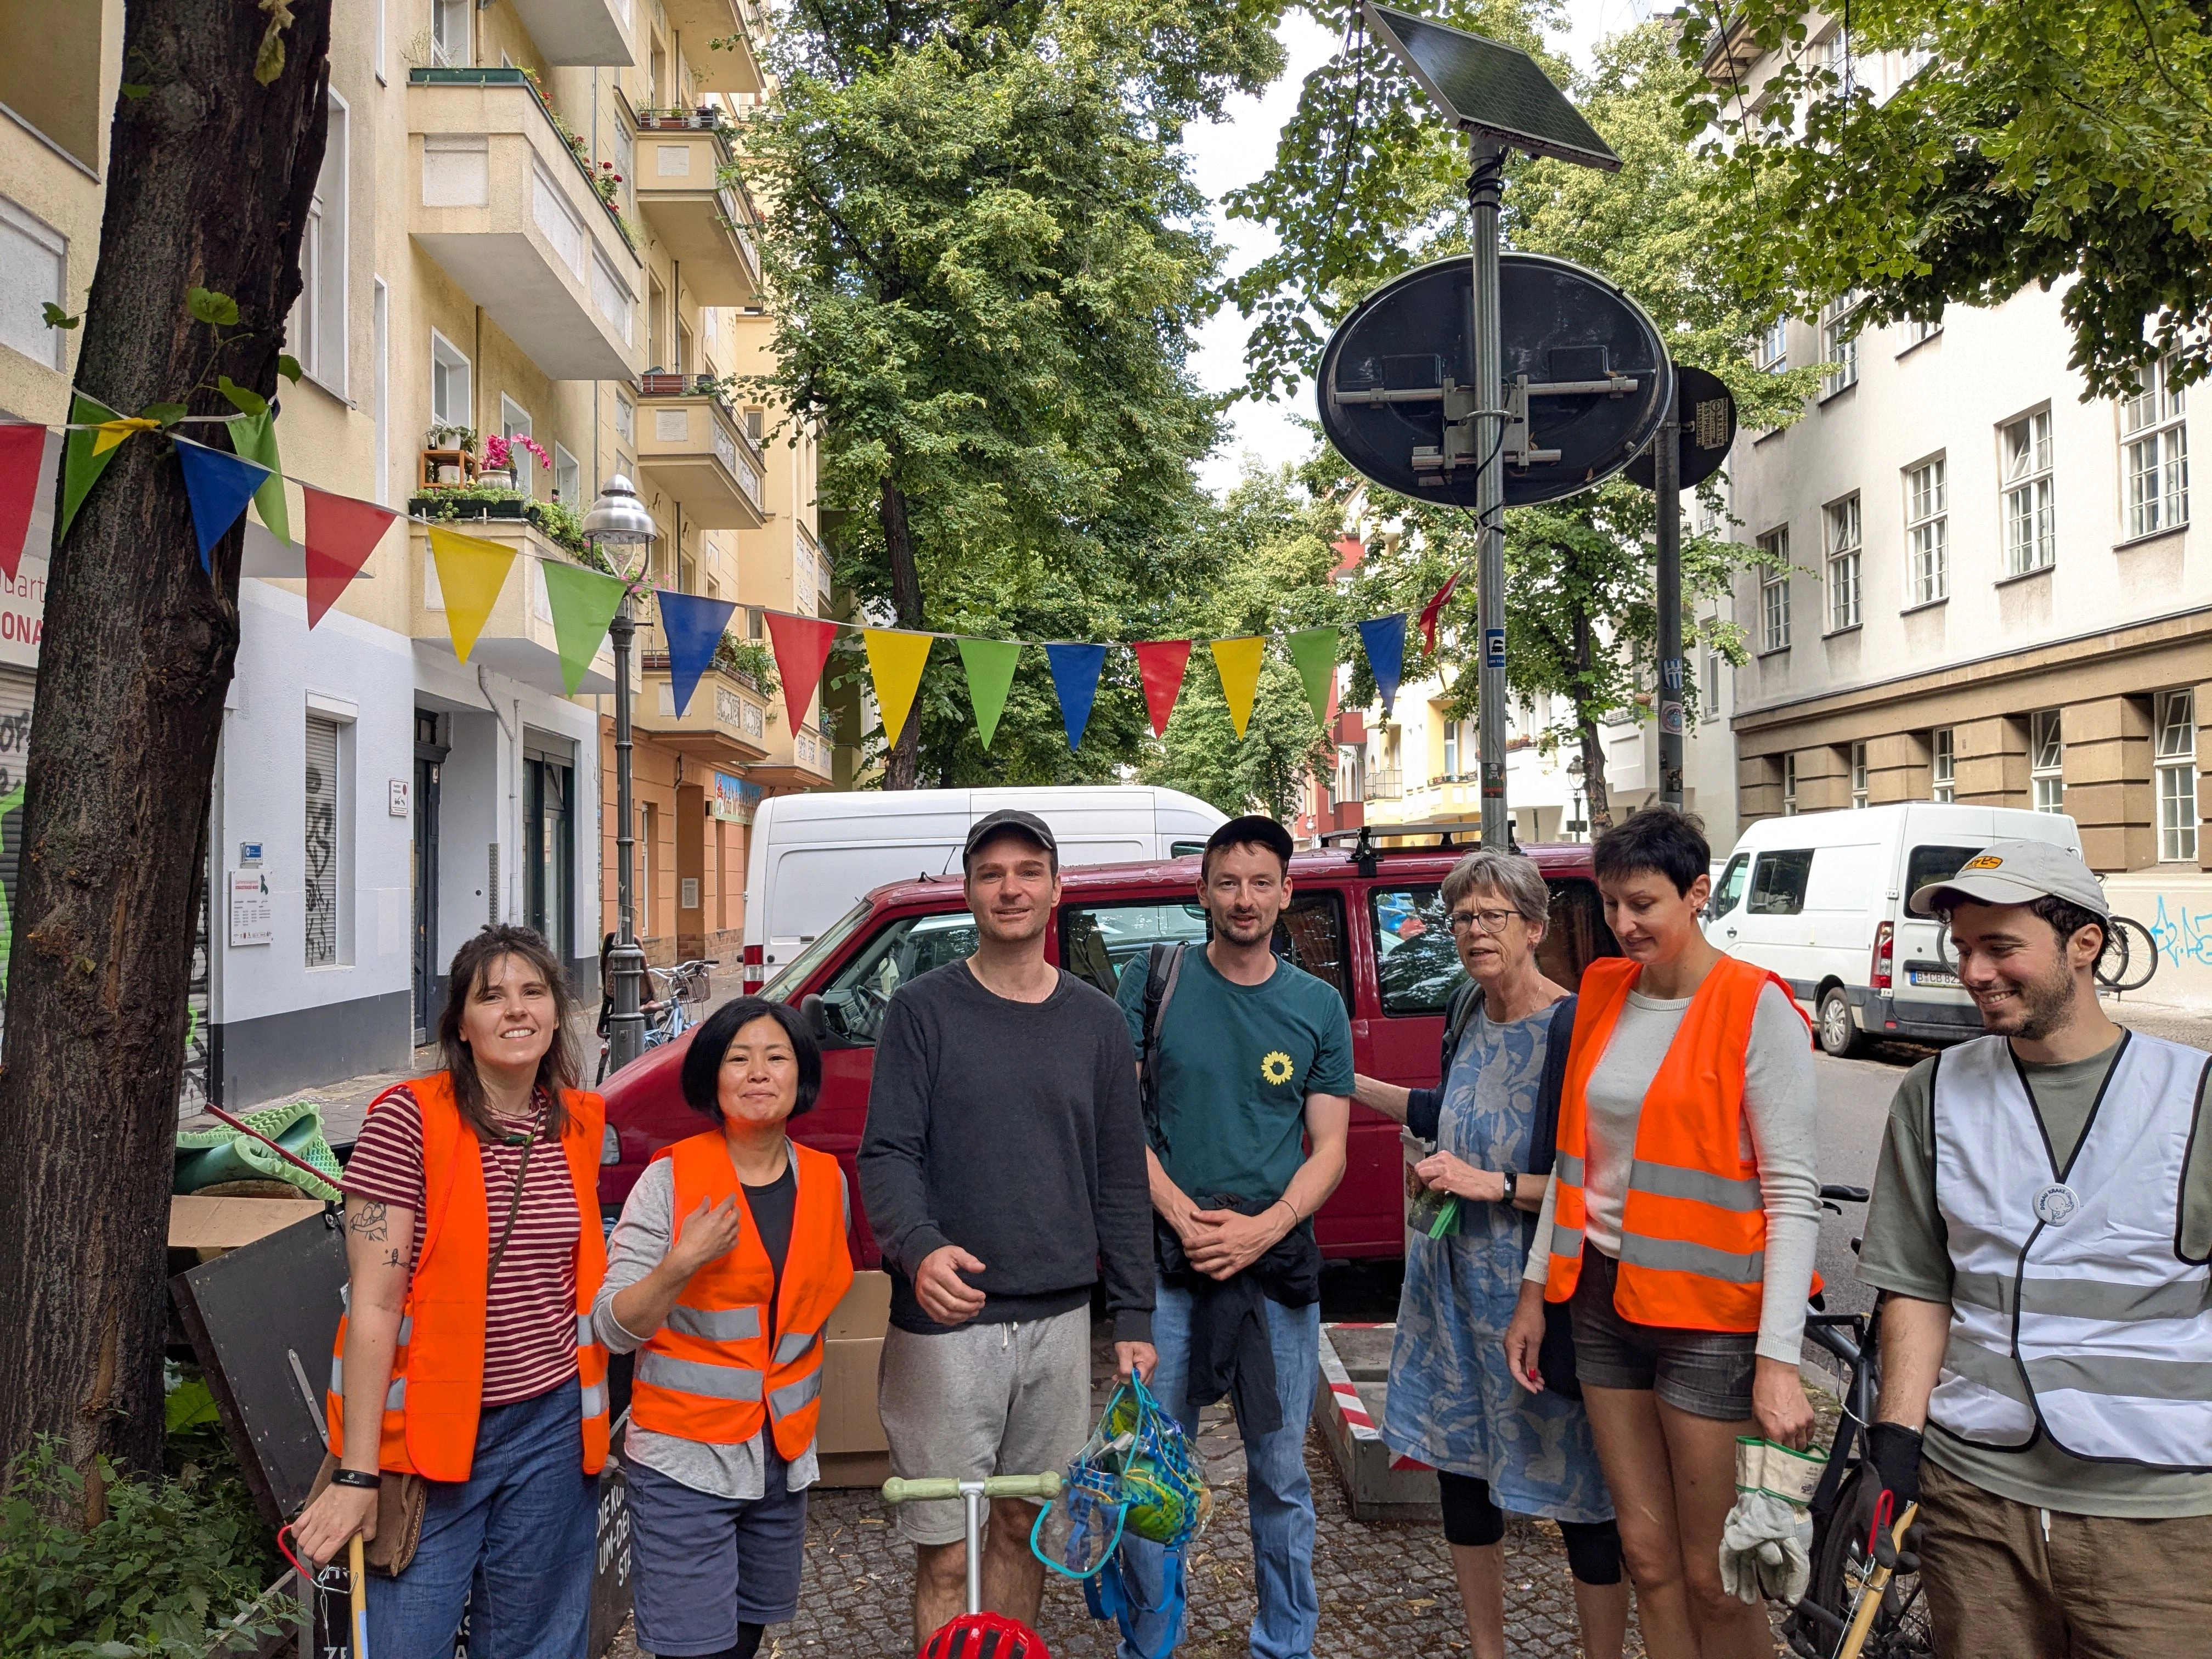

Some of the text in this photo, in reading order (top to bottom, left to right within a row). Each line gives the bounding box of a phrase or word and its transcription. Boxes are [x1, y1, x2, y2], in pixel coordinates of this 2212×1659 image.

[1917, 972, 1961, 984] B CB 82
[2040, 1193, 2049, 1210] DONAU
